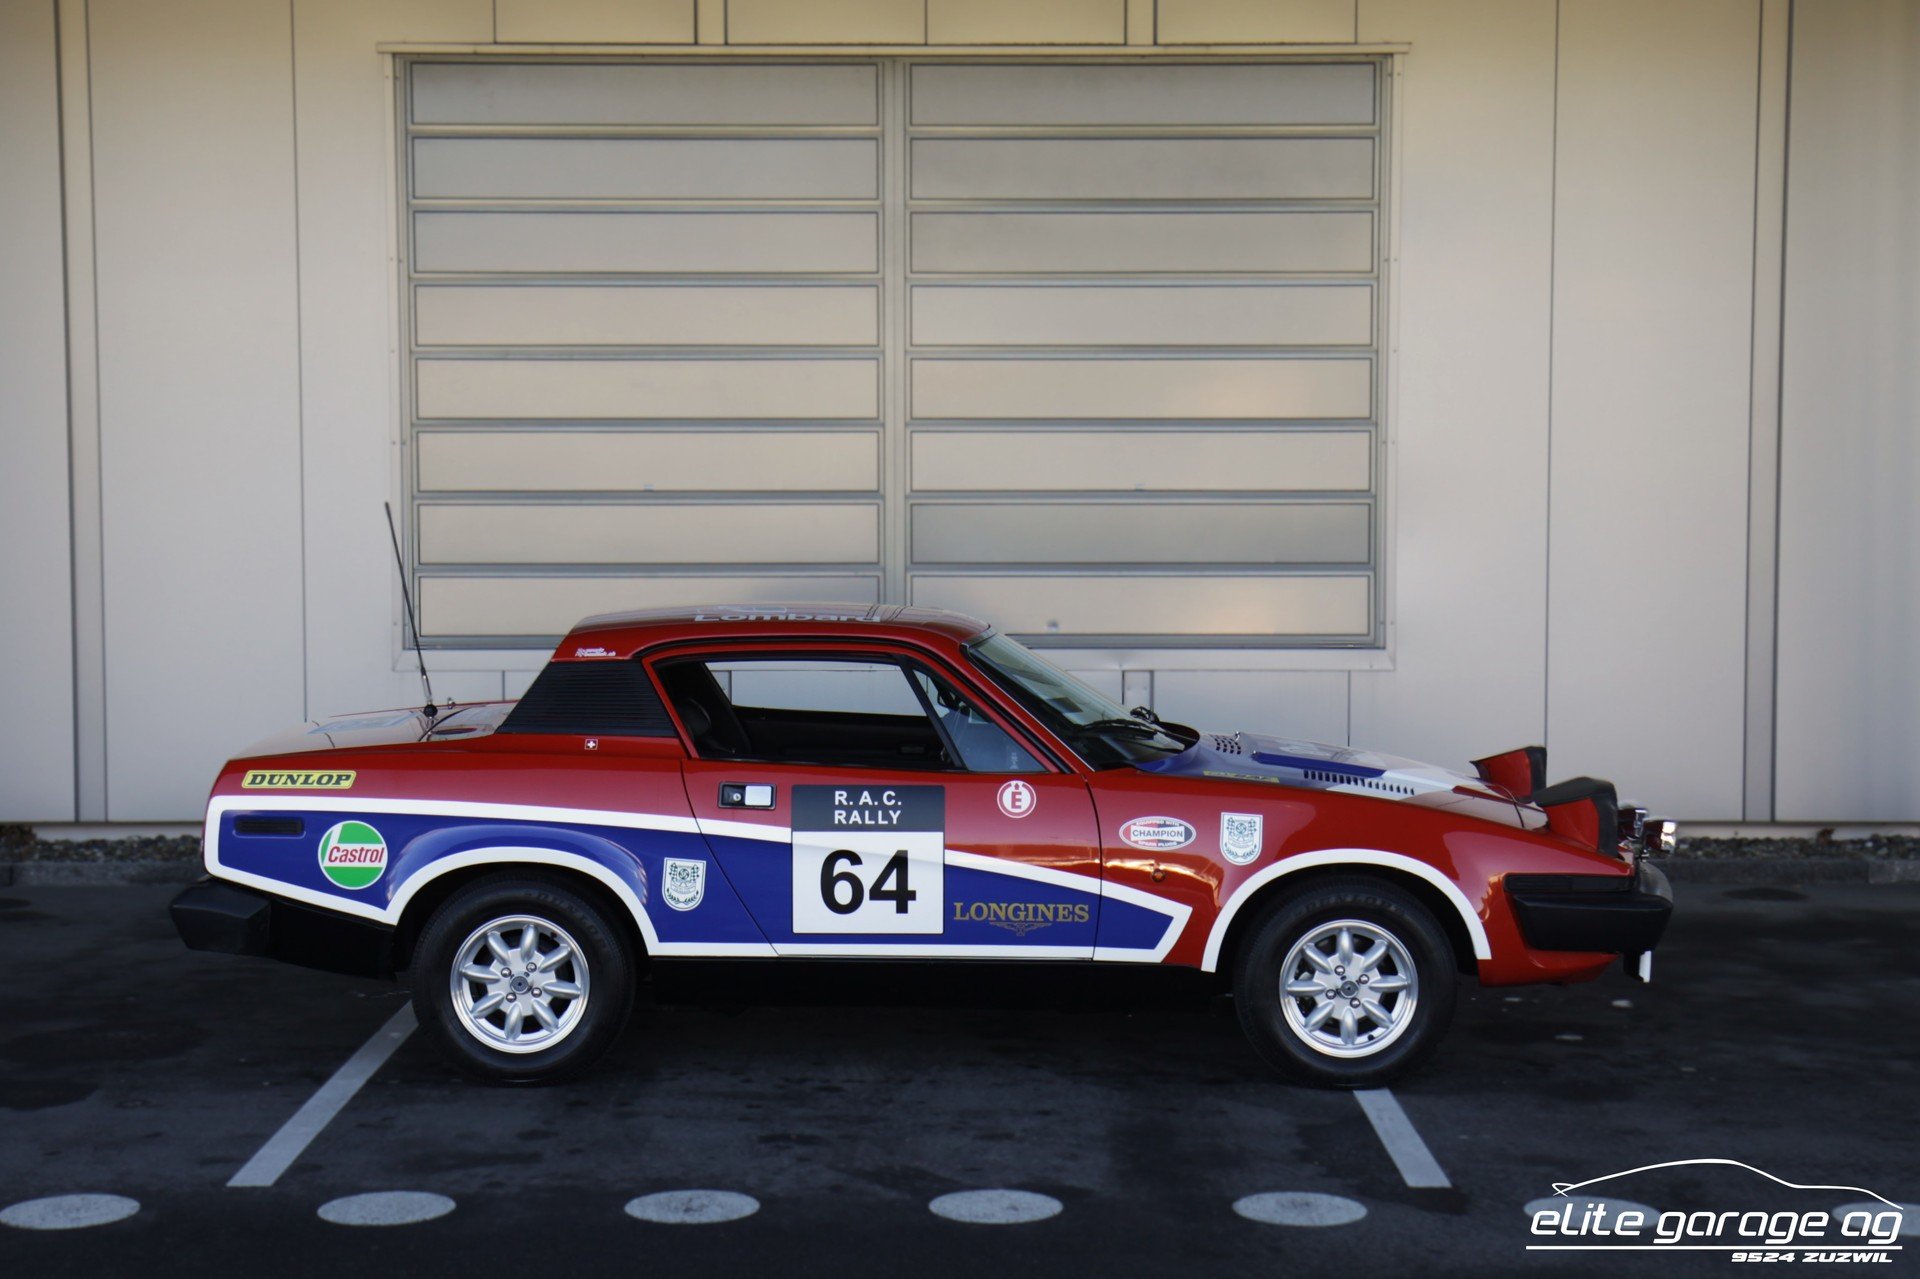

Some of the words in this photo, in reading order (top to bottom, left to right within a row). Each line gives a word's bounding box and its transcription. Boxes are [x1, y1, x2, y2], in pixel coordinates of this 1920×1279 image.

[694, 613, 881, 622] Lombard
[248, 773, 352, 786] DUNLOP
[834, 810, 902, 825] RALLY
[1132, 829, 1184, 837] CHAMPION
[328, 846, 385, 863] Castrol
[820, 849, 917, 915] 64
[953, 902, 1090, 923] LONGINES
